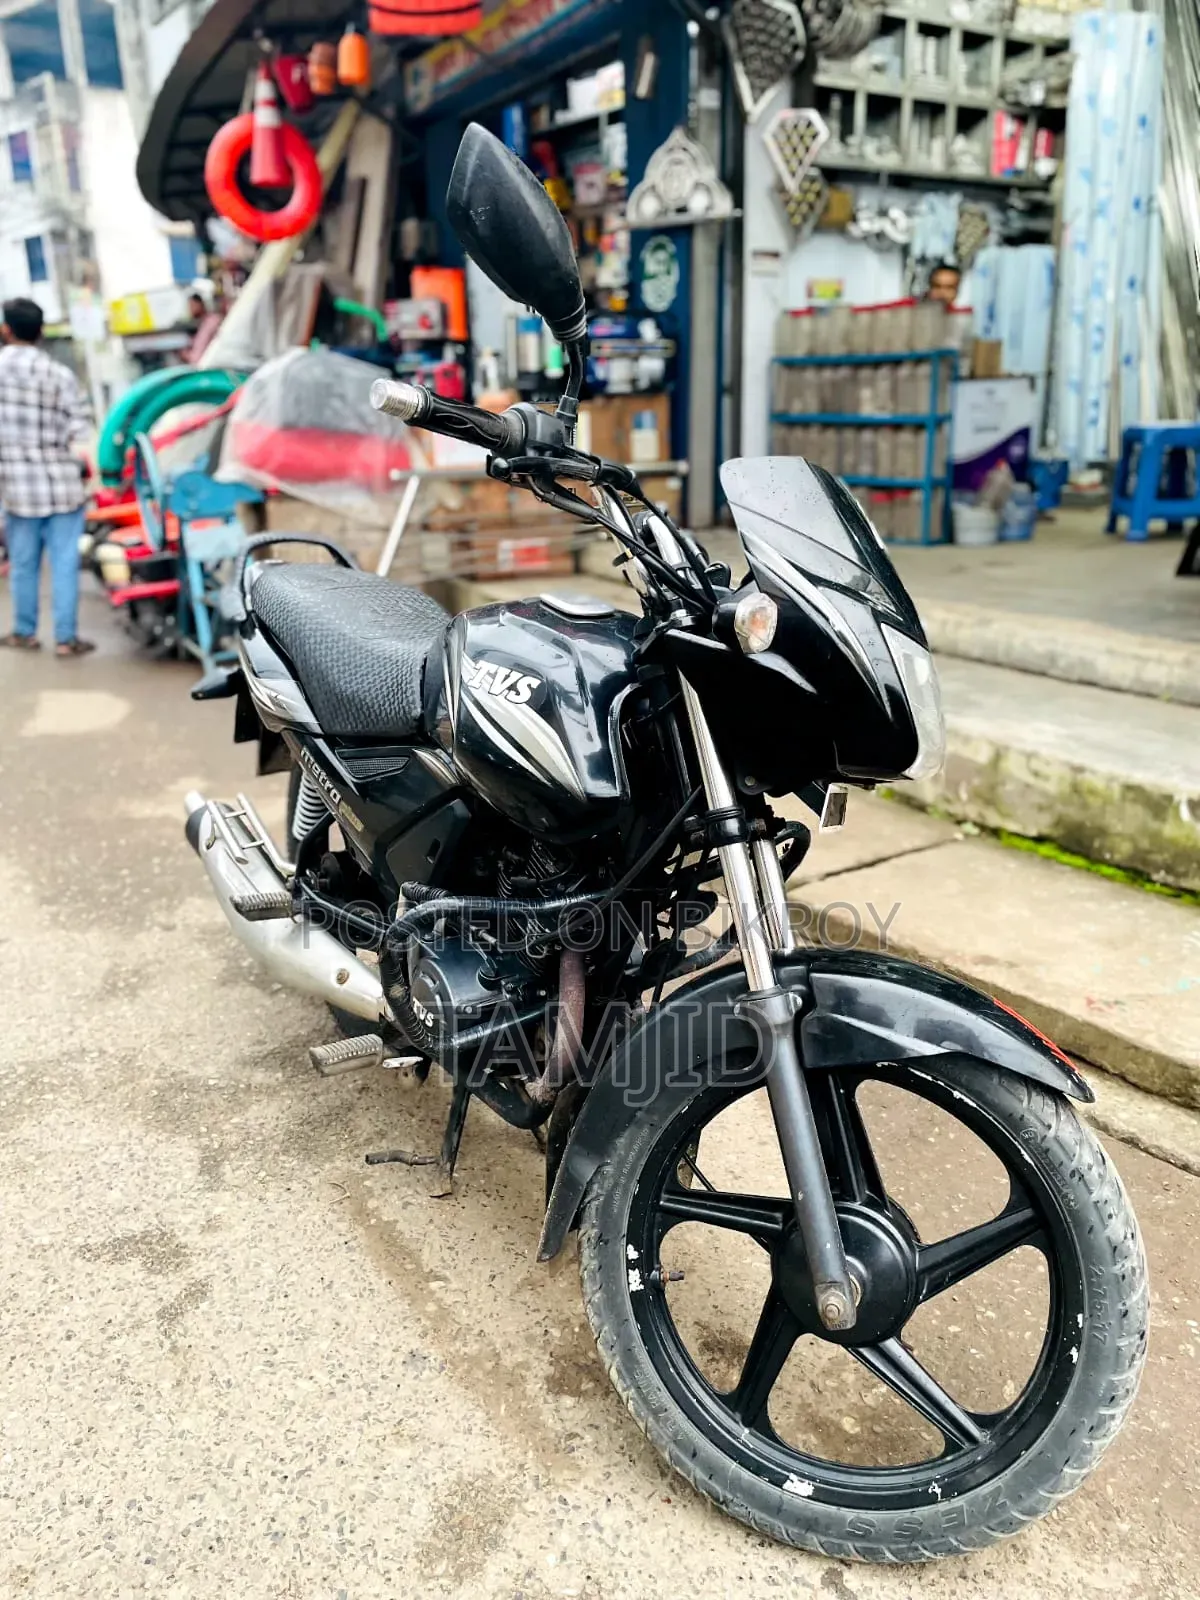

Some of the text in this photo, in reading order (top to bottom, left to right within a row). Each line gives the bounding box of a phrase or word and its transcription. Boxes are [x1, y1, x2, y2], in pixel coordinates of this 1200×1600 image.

[467, 660, 541, 704] TVS
[300, 746, 341, 804] metro
[412, 996, 434, 1028] TVS
